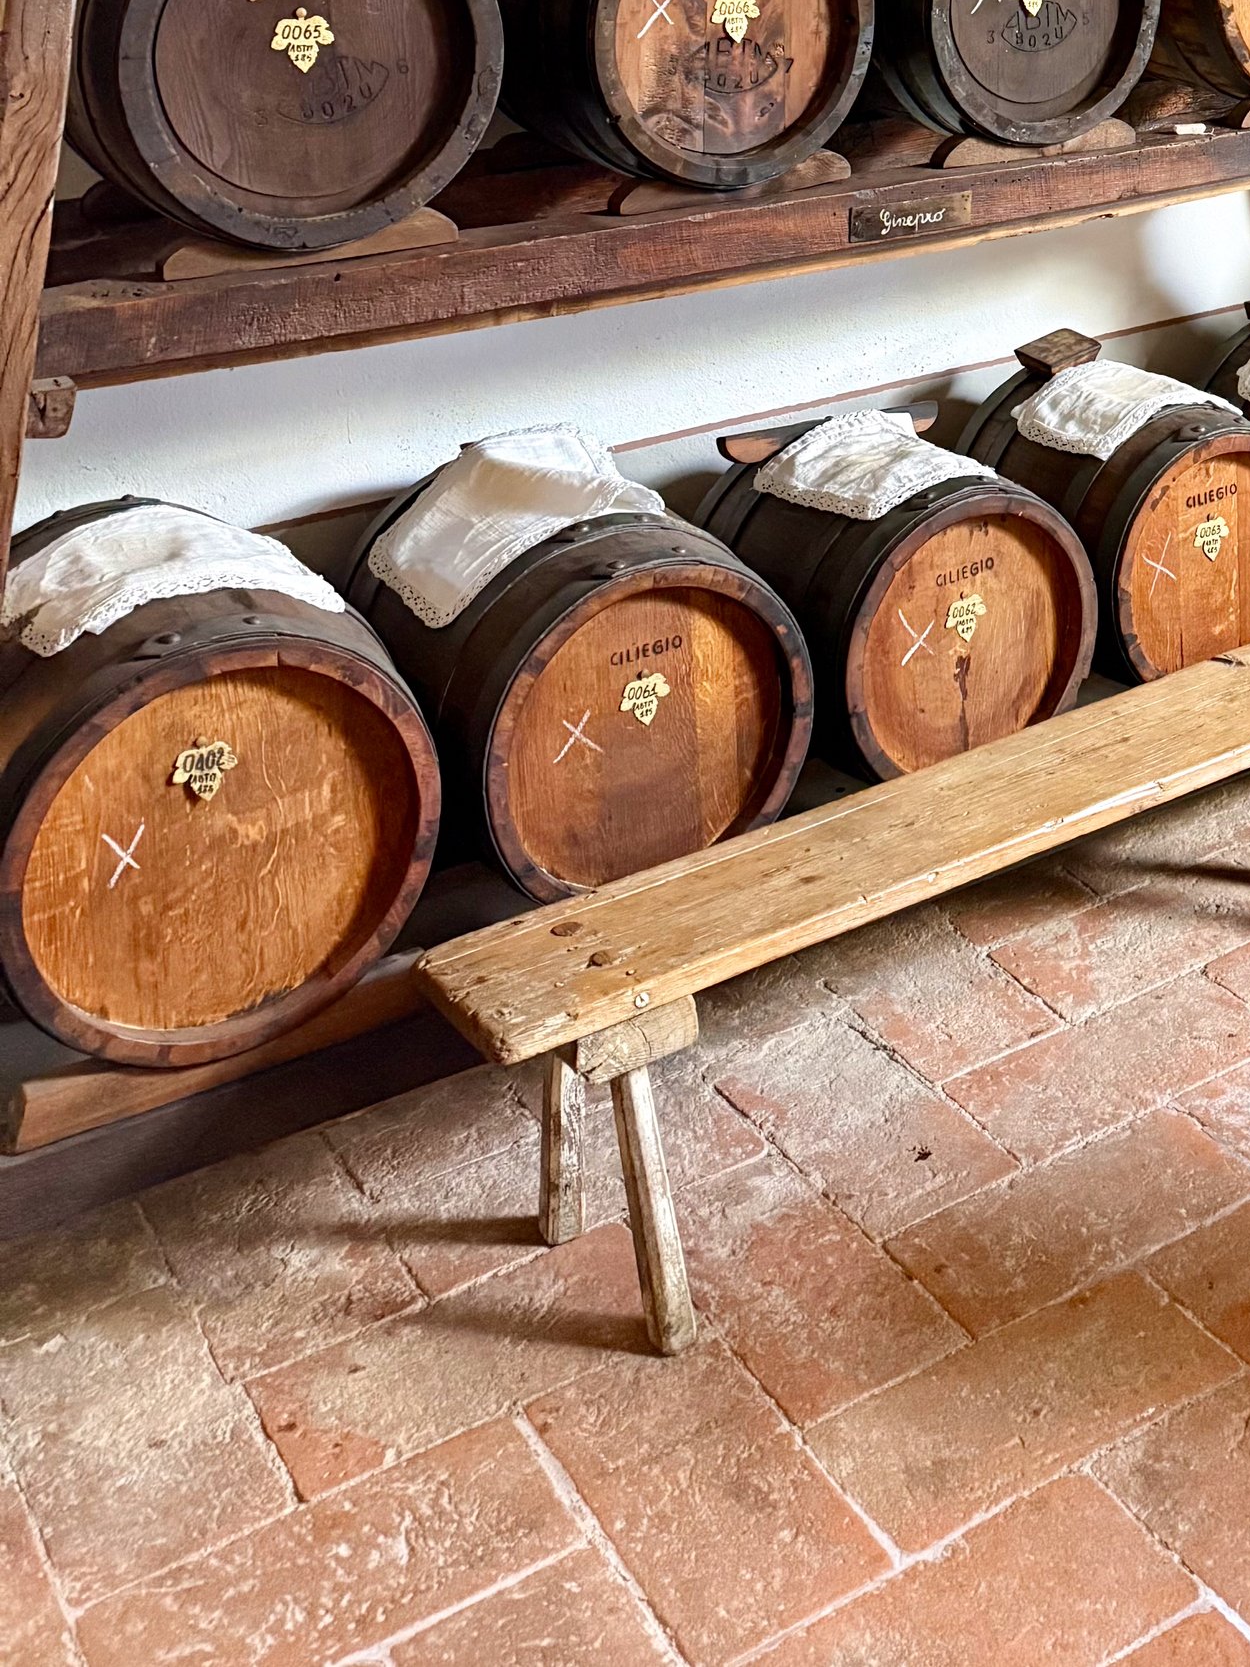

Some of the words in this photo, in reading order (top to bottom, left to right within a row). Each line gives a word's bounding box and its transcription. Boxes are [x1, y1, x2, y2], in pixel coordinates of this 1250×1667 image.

[719, 1, 750, 16] 0066
[281, 24, 322, 41] 0065
[290, 44, 313, 54] ABTM
[880, 208, 946, 235] Ginepro
[1186, 483, 1238, 508] CILIEGIO
[1199, 524, 1221, 539] 0063
[936, 557, 995, 587] CILIEGIO
[952, 602, 977, 619] 0062
[610, 635, 683, 666] CILIEGIO
[628, 683, 658, 701] 0061
[182, 747, 225, 773] 0402
